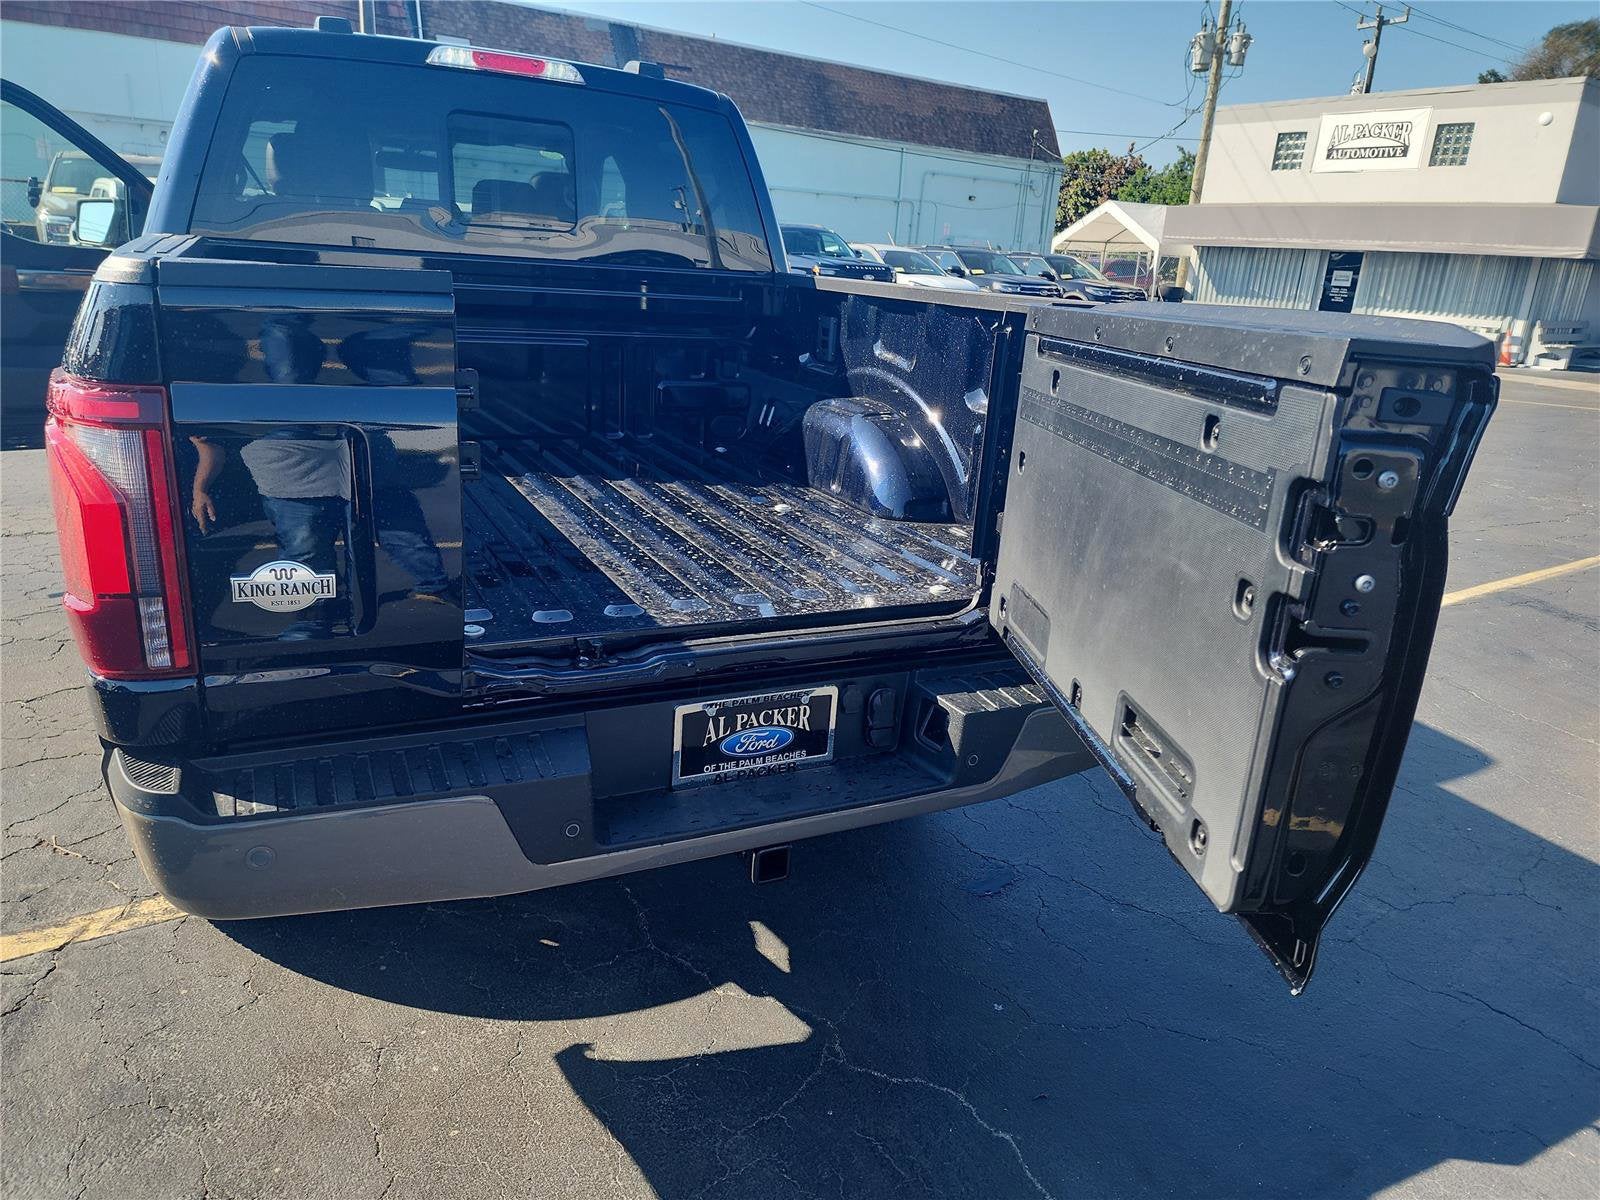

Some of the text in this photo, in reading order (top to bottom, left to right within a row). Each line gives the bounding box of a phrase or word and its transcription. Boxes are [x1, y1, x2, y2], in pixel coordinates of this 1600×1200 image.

[1328, 121, 1412, 149] AL PACKER
[1329, 147, 1404, 159] AUTOMOTIVE
[237, 579, 331, 598] KING RANCH
[732, 696, 760, 707] PALM
[763, 690, 809, 702] BEACHES
[703, 705, 811, 747] AL PACKER
[735, 731, 779, 753] Ford
[703, 750, 807, 773] OF THE PALM BEACHES
